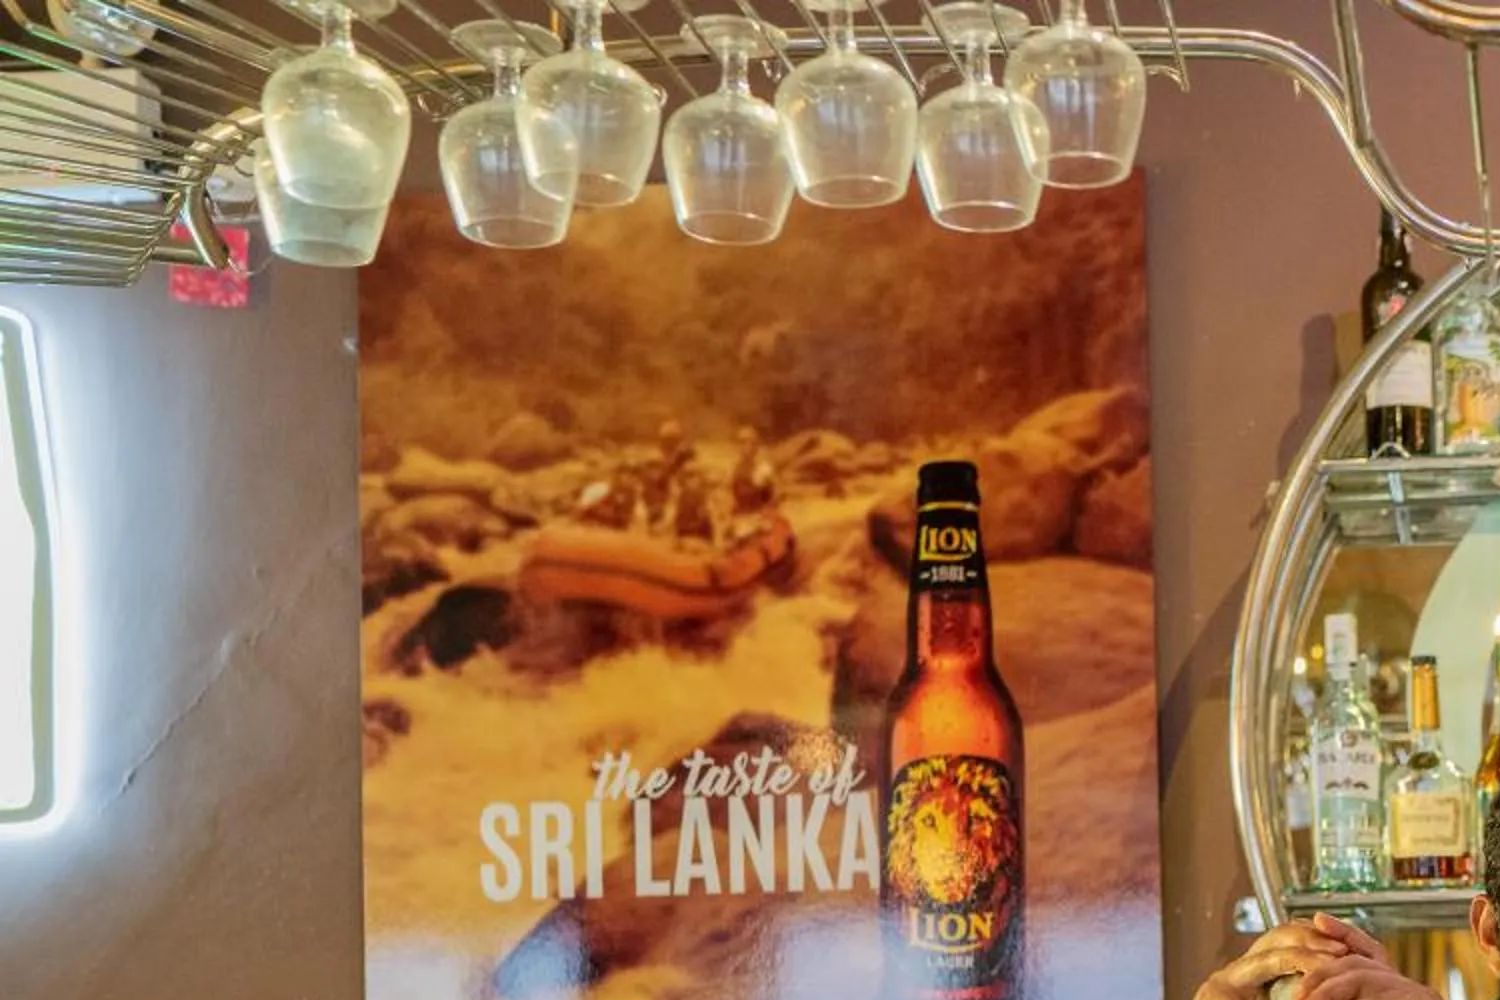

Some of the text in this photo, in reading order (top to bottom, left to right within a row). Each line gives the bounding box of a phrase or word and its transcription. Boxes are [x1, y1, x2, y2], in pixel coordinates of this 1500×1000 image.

[919, 525, 977, 560] LION
[590, 745, 866, 804] the taste of
[479, 788, 880, 903] SRI LANKA
[909, 906, 994, 954] LION
